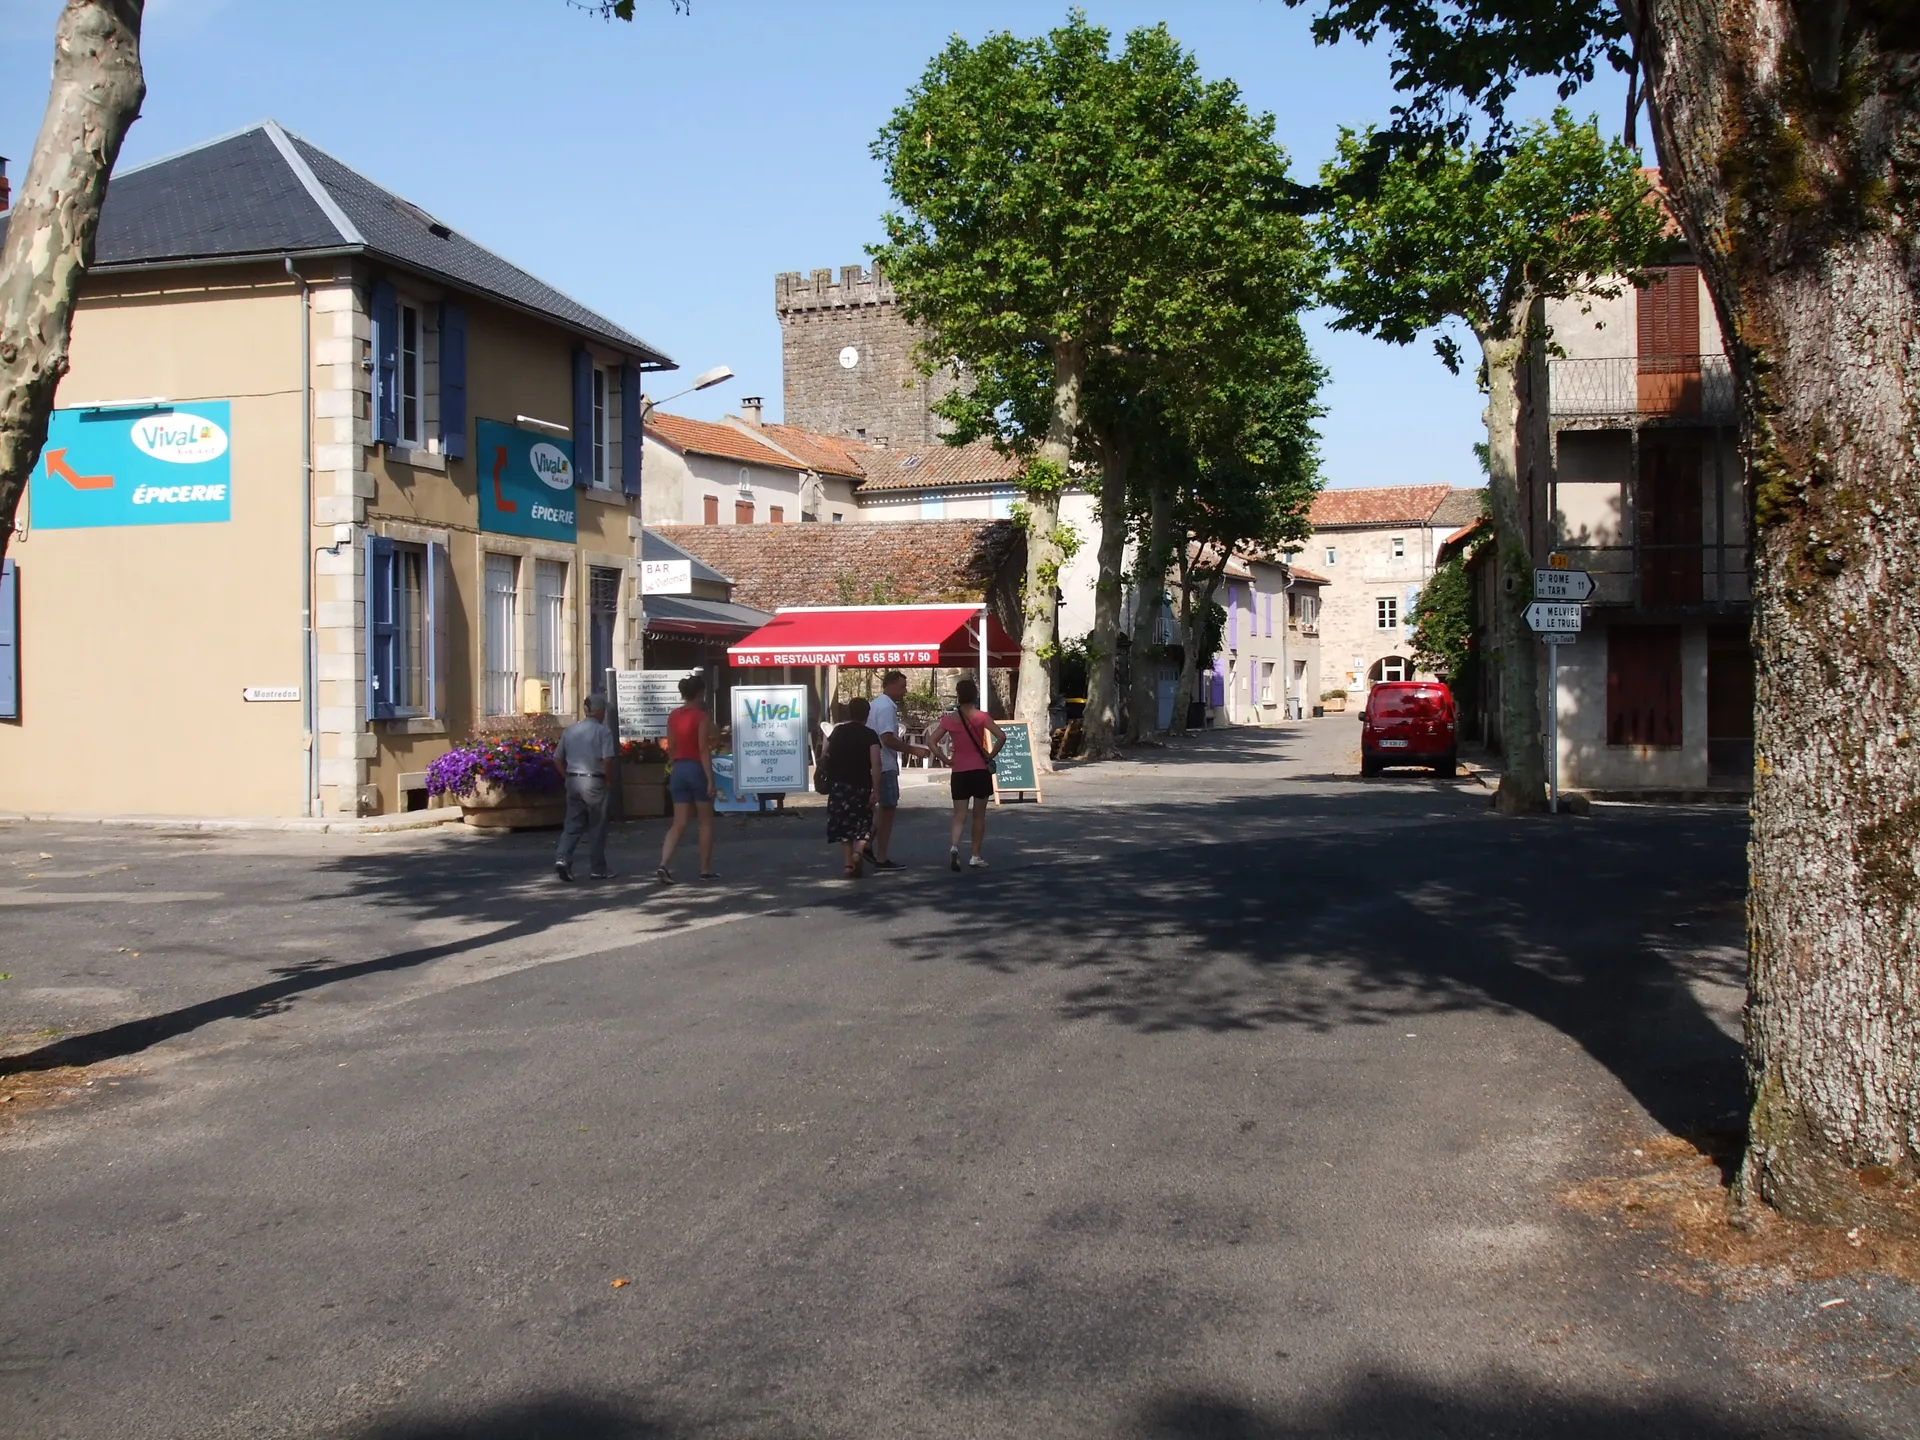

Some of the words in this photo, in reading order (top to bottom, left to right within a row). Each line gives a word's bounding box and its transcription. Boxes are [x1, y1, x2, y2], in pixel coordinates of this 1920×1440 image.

[132, 484, 227, 505] ÉPICERIE
[531, 502, 574, 524] ÉPICERIE
[646, 563, 670, 574] BAR
[1548, 574, 1570, 584] ROME
[1548, 586, 1566, 595] TARN
[1577, 581, 1585, 590] 11
[1535, 606, 1540, 616] 4
[1547, 607, 1580, 616] MELVIEU
[1535, 618, 1540, 628] 8
[1547, 619, 1555, 628] LE
[1558, 619, 1579, 628] TRUEL
[737, 655, 761, 665] BAR
[774, 653, 846, 664] RESTAURANT
[857, 653, 870, 663] 05
[872, 653, 886, 663] 65
[887, 652, 901, 663] 58
[902, 652, 916, 662] 17
[917, 652, 931, 662] 50
[253, 690, 297, 698] Montredon
